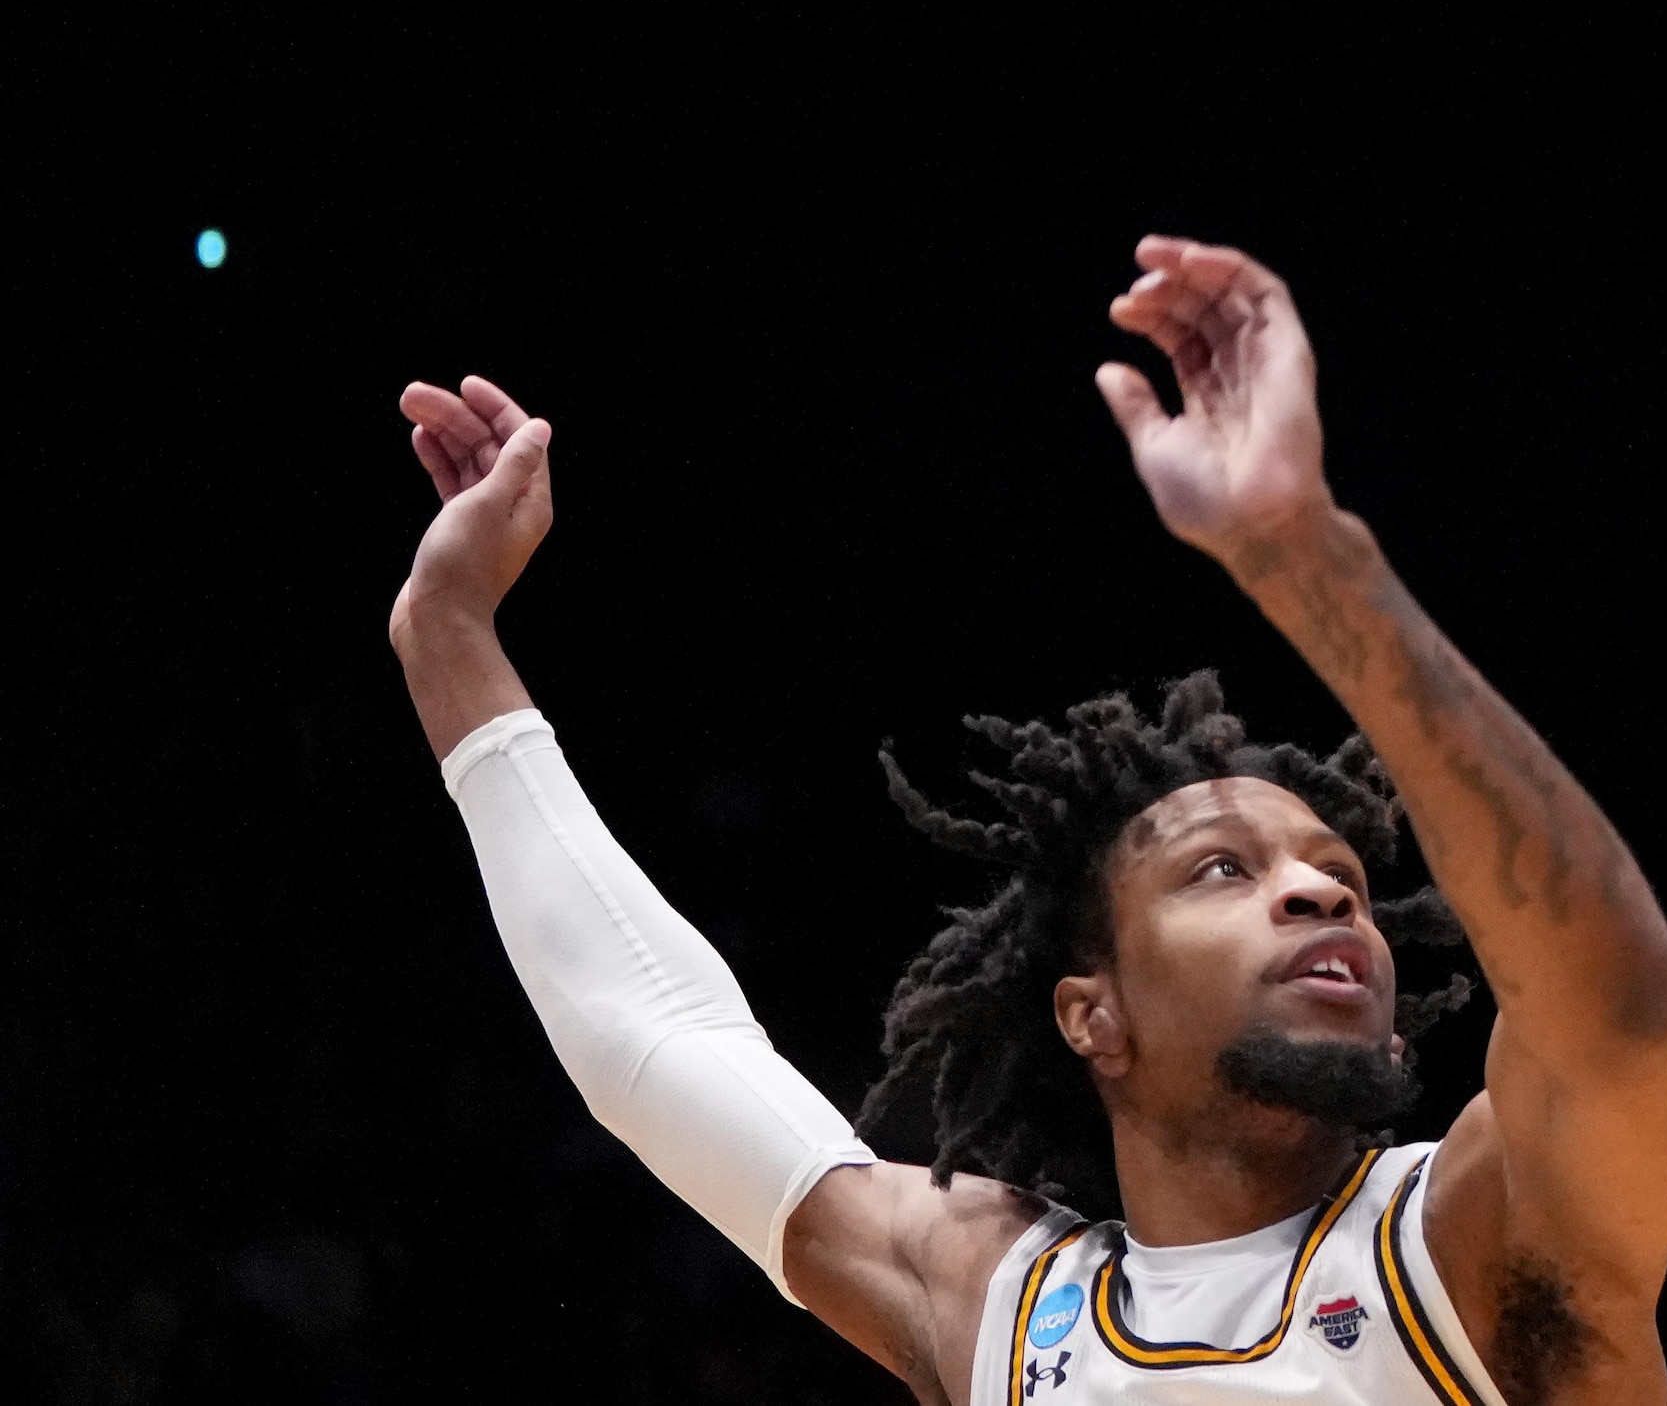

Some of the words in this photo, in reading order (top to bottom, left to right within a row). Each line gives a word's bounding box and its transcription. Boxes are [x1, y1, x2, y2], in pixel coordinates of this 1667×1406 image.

[1034, 1307, 1078, 1334] NCAA
[1308, 1305, 1370, 1330] AMERICA
[1323, 1322, 1359, 1338] EAST
